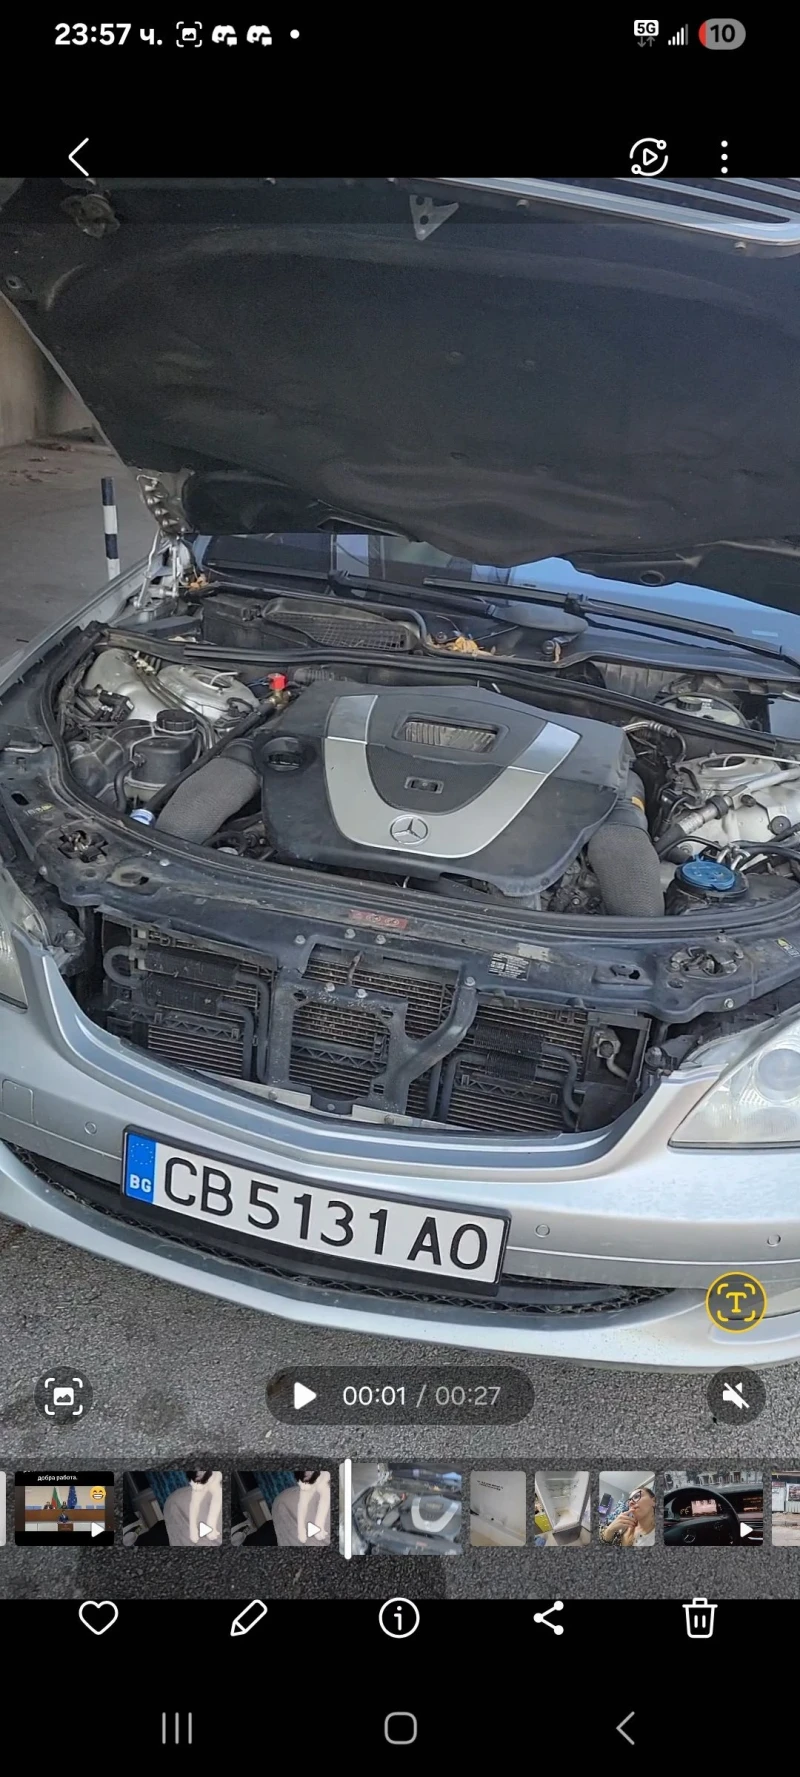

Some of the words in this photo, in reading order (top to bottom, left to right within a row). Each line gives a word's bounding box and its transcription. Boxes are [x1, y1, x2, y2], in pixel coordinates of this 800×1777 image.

[129, 1174, 152, 1193] BG
[164, 1157, 233, 1217] CB
[247, 1179, 388, 1256] 5131
[406, 1216, 488, 1270] AO
